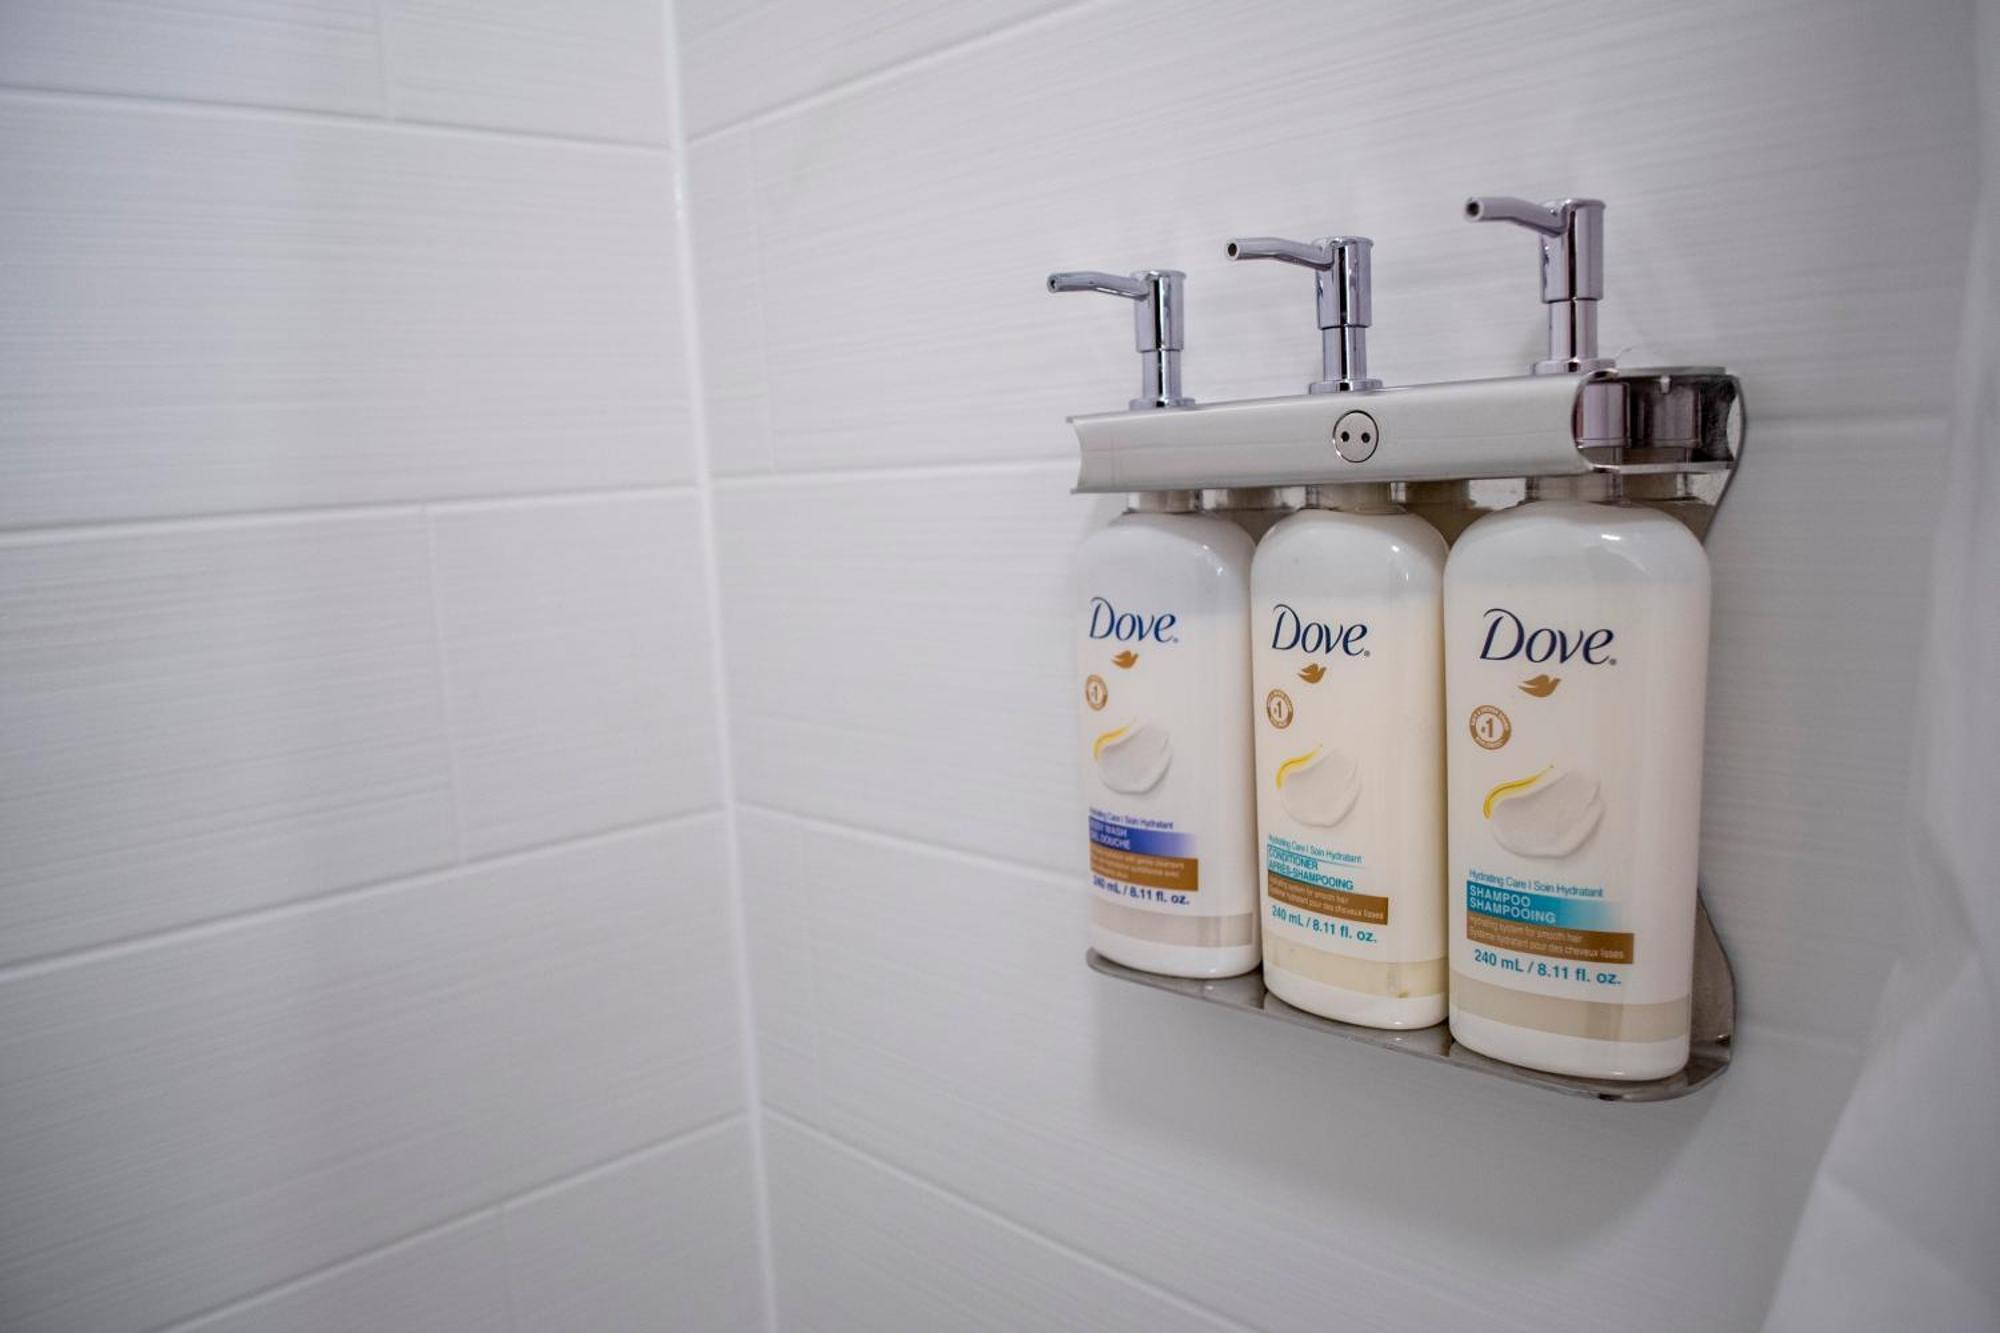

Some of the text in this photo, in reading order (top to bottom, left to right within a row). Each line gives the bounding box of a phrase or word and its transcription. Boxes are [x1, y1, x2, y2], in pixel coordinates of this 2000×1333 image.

[1089, 596, 1177, 643] Dove
[1272, 603, 1368, 656] Dove
[1480, 608, 1615, 665] Dove
[1130, 886, 1152, 900] 8.11
[1171, 894, 1190, 905] oz.
[1469, 869, 1505, 887] Hydrating
[1505, 876, 1527, 889] Care
[1533, 881, 1554, 893] Soin
[1556, 884, 1603, 897] Hydratant
[1469, 884, 1531, 908] SHAMPOO
[1272, 905, 1286, 921] 240
[1289, 912, 1303, 927] mL
[1312, 918, 1336, 935] 8.11
[1340, 925, 1352, 939] fl.
[1357, 930, 1377, 943] oz.
[1469, 897, 1557, 924] SHAMPOOING
[1475, 949, 1497, 967] 240
[1501, 957, 1524, 972] mL
[1537, 963, 1568, 979] 8.11
[1576, 968, 1590, 982] fl.
[1596, 972, 1621, 985] oz.
